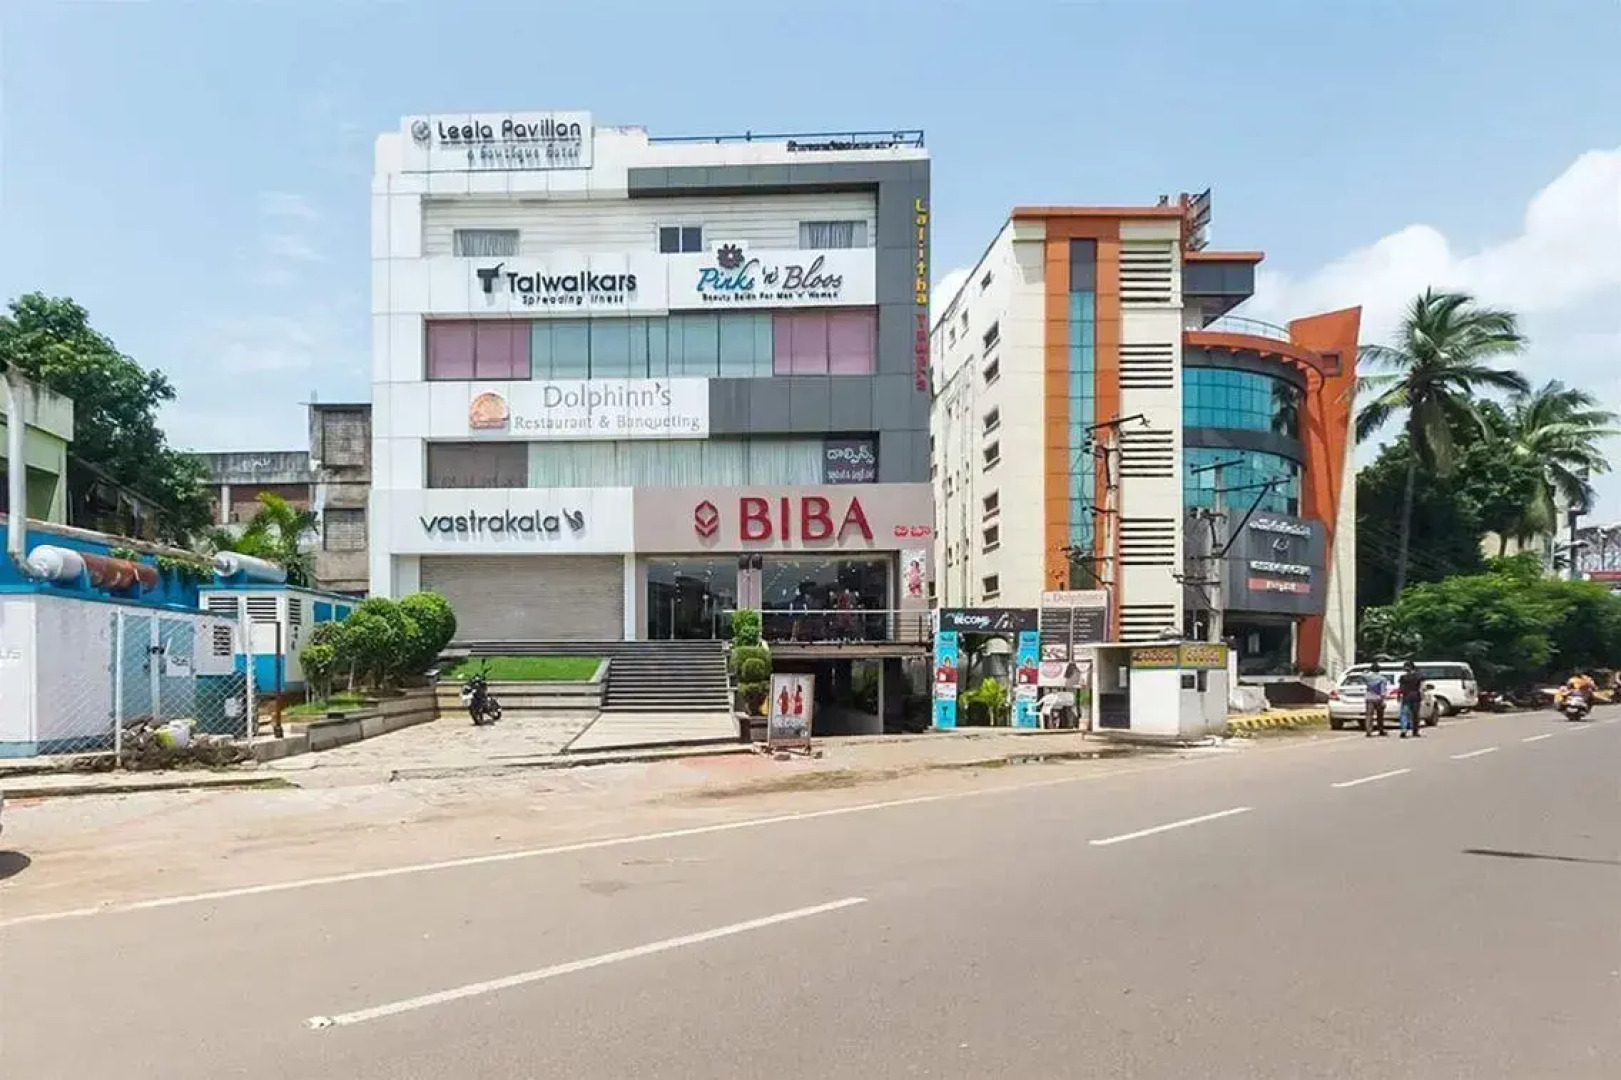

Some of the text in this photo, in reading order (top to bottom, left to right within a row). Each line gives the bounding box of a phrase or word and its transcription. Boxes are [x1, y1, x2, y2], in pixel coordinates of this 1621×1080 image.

[438, 120, 493, 139] Leela
[507, 271, 637, 293] Talwalkars
[543, 382, 672, 415] Dolphinn's
[514, 415, 700, 431] Restaurant & Banqueting
[420, 509, 560, 532] vastrakala
[739, 496, 873, 541] BIBA
